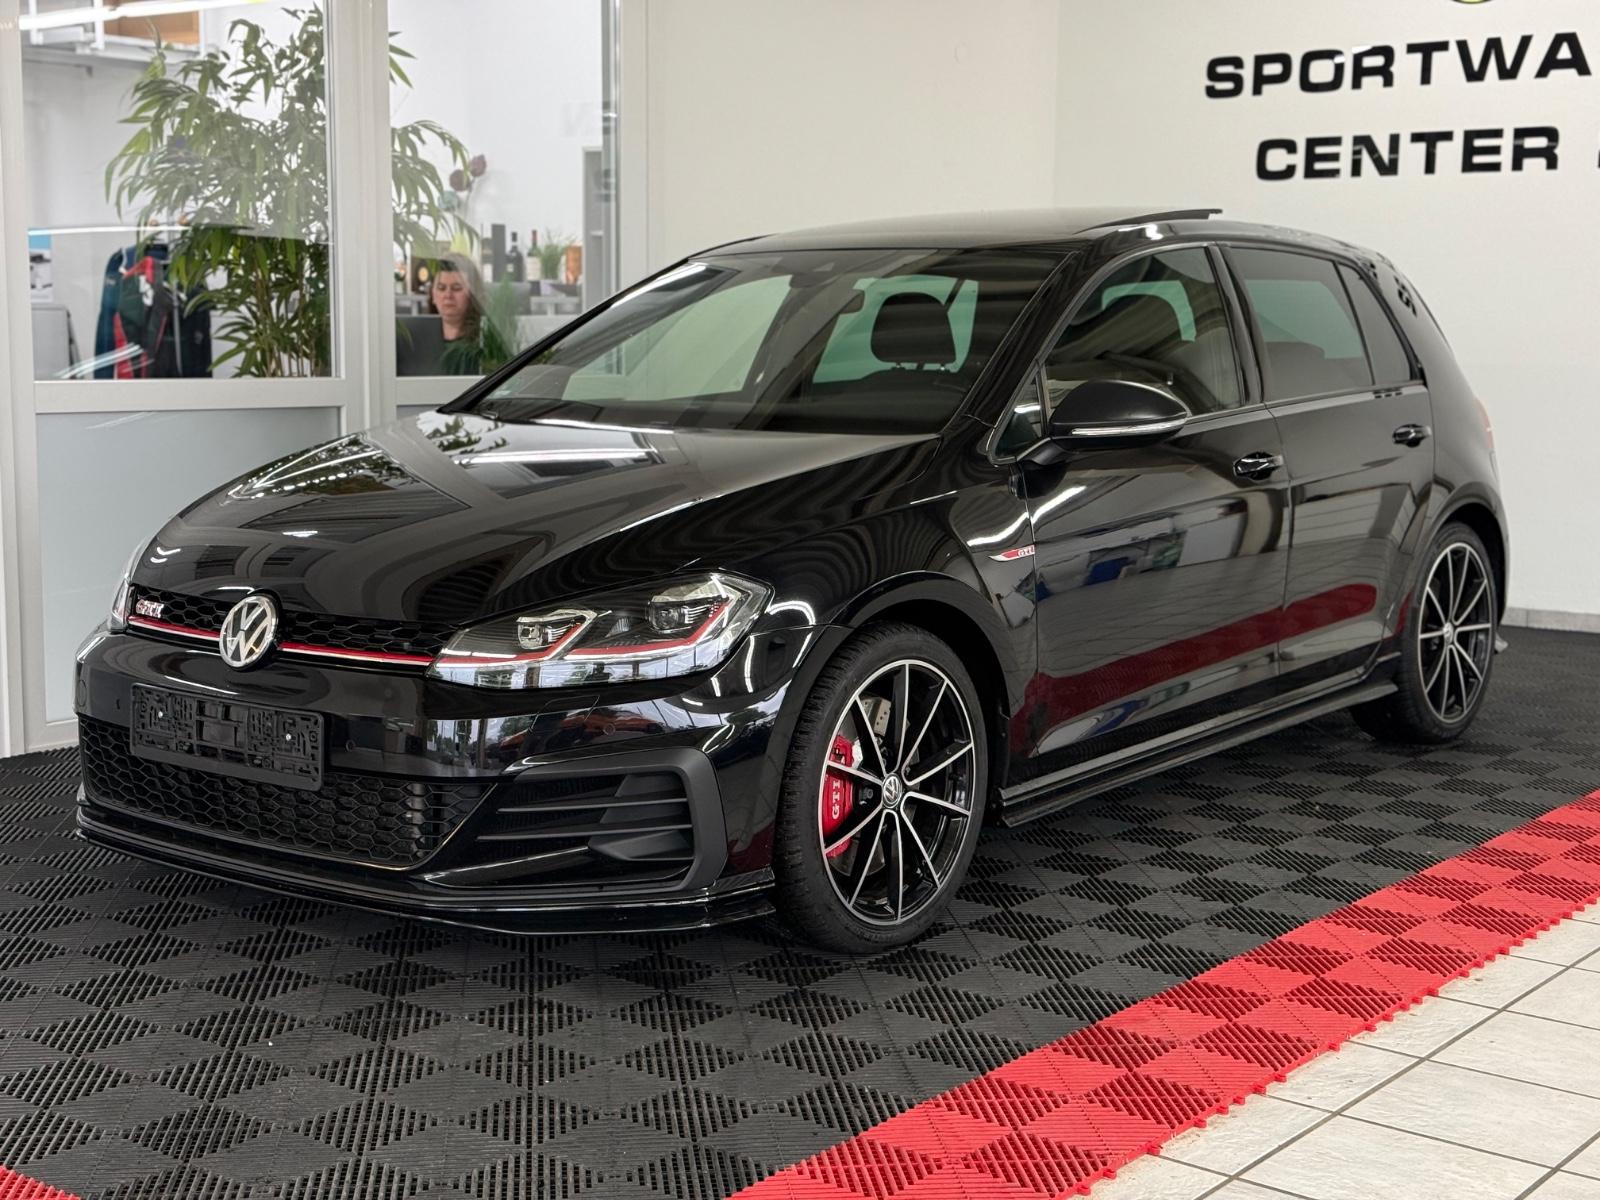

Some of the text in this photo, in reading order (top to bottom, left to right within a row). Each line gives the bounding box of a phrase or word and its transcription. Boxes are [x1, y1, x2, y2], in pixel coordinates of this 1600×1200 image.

[1205, 32, 1592, 98] SPORTWA
[1256, 126, 1560, 180] CENTER
[136, 599, 164, 618] GTI
[832, 780, 841, 819] GTI
